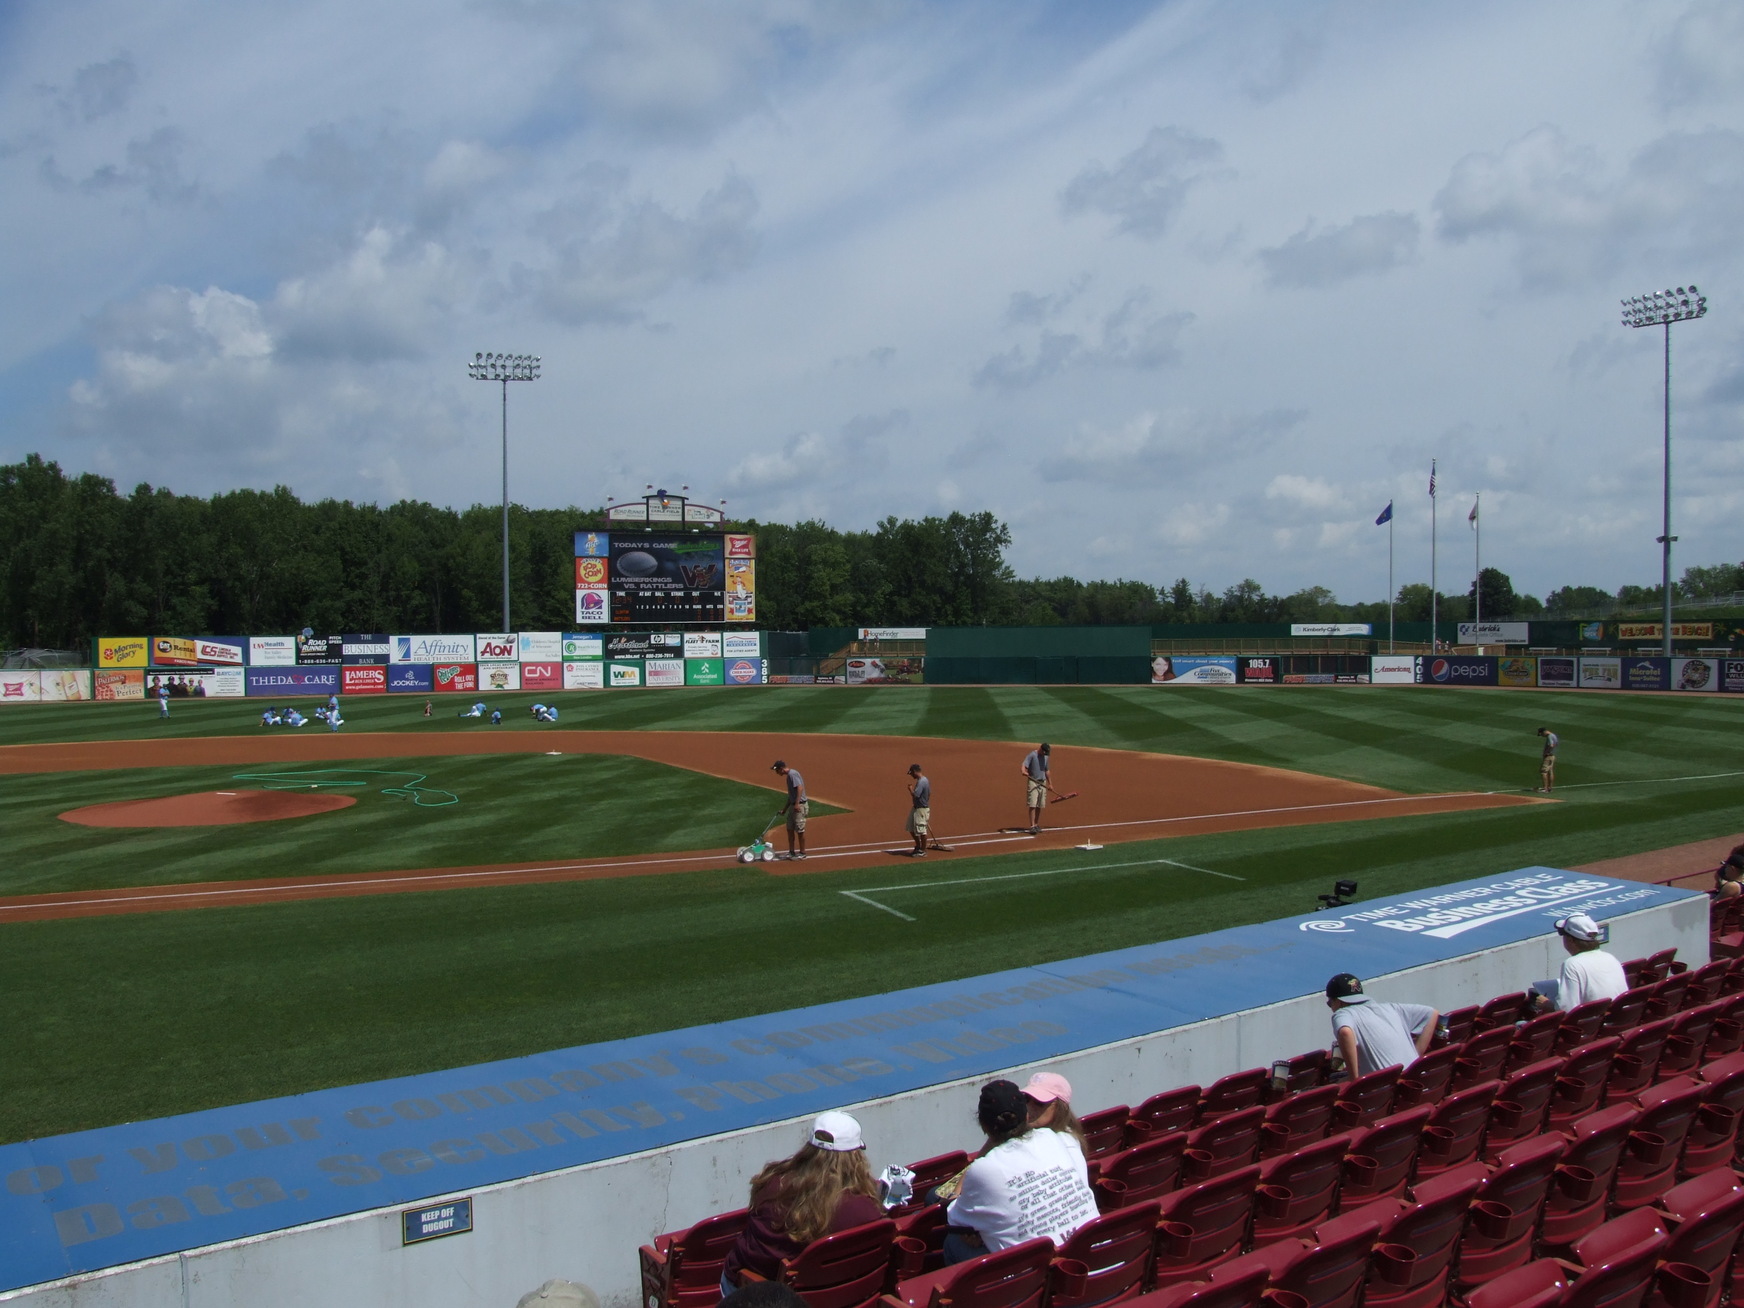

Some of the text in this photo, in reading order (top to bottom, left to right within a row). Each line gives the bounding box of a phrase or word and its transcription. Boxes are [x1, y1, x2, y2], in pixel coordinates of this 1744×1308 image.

[114, 643, 143, 655] Morning
[174, 644, 195, 653] Rental
[344, 645, 389, 654] BUSINESS
[414, 640, 469, 655] Affinity
[481, 642, 513, 657] AON
[117, 651, 136, 662] Glory
[648, 662, 681, 671] MARIAN
[1248, 659, 1270, 668] 105.7
[1727, 662, 1744, 673] FO
[525, 666, 551, 677] CN
[1374, 666, 1411, 674] American
[1451, 664, 1488, 678] pepsi
[251, 675, 294, 686] THEDA
[304, 675, 336, 686] CARE
[346, 670, 384, 683] LAMERS
[116, 688, 142, 697] Perfect
[1342, 873, 1564, 922] TIME WARNER CABLE
[1372, 880, 1609, 932] Business Class
[6, 1150, 105, 1195] or
[126, 1114, 322, 1176] your
[344, 1040, 729, 1131] company's
[421, 1207, 455, 1222] KEEP OFF
[422, 1218, 454, 1233] DUGOUT
